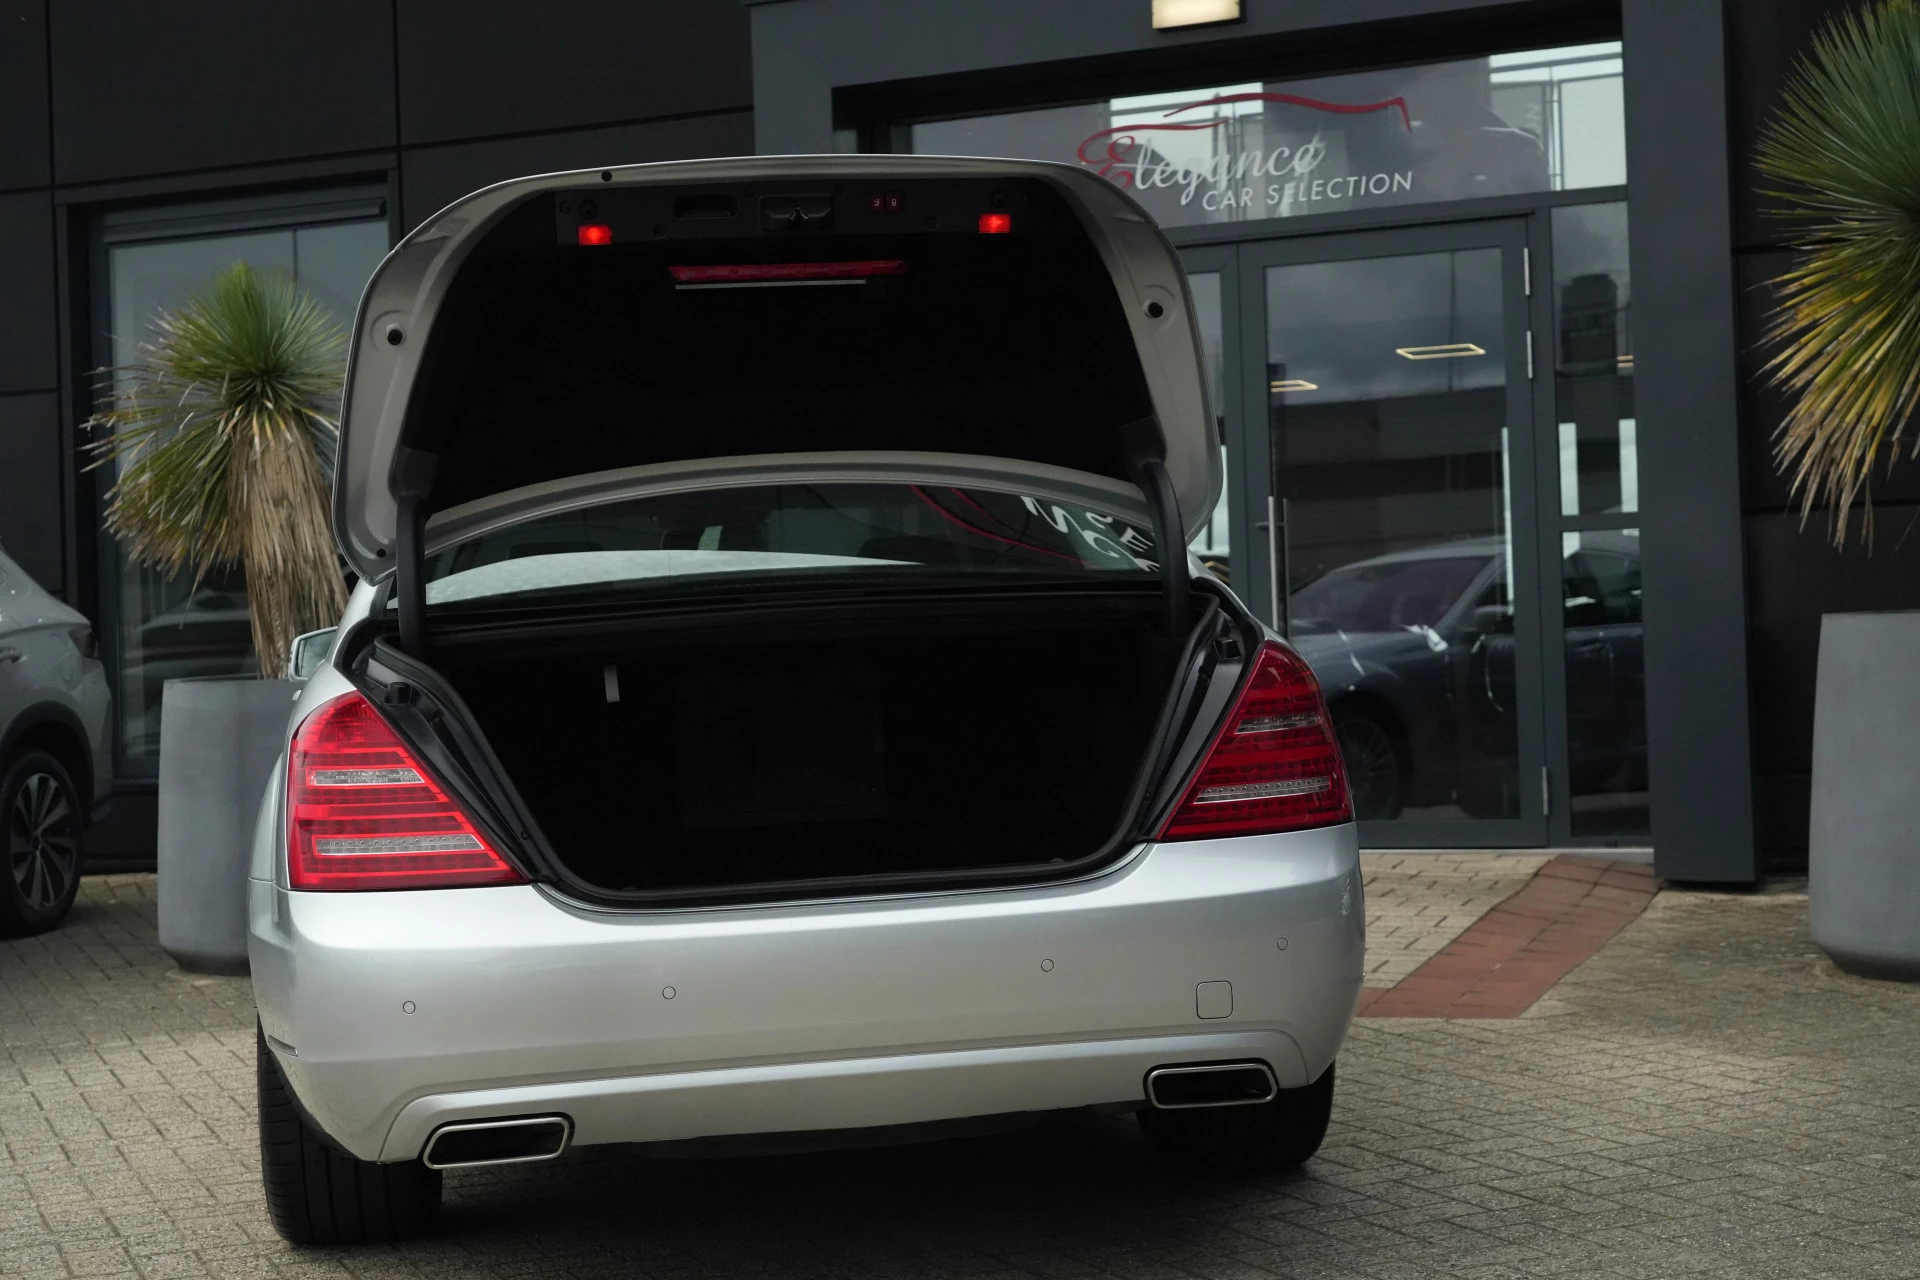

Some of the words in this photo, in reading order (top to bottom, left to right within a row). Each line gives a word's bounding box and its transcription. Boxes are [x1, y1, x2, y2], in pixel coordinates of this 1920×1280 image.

[1096, 135, 1327, 206] Elegance
[1201, 187, 1254, 211] CAR
[1266, 171, 1413, 205] SELECTION
